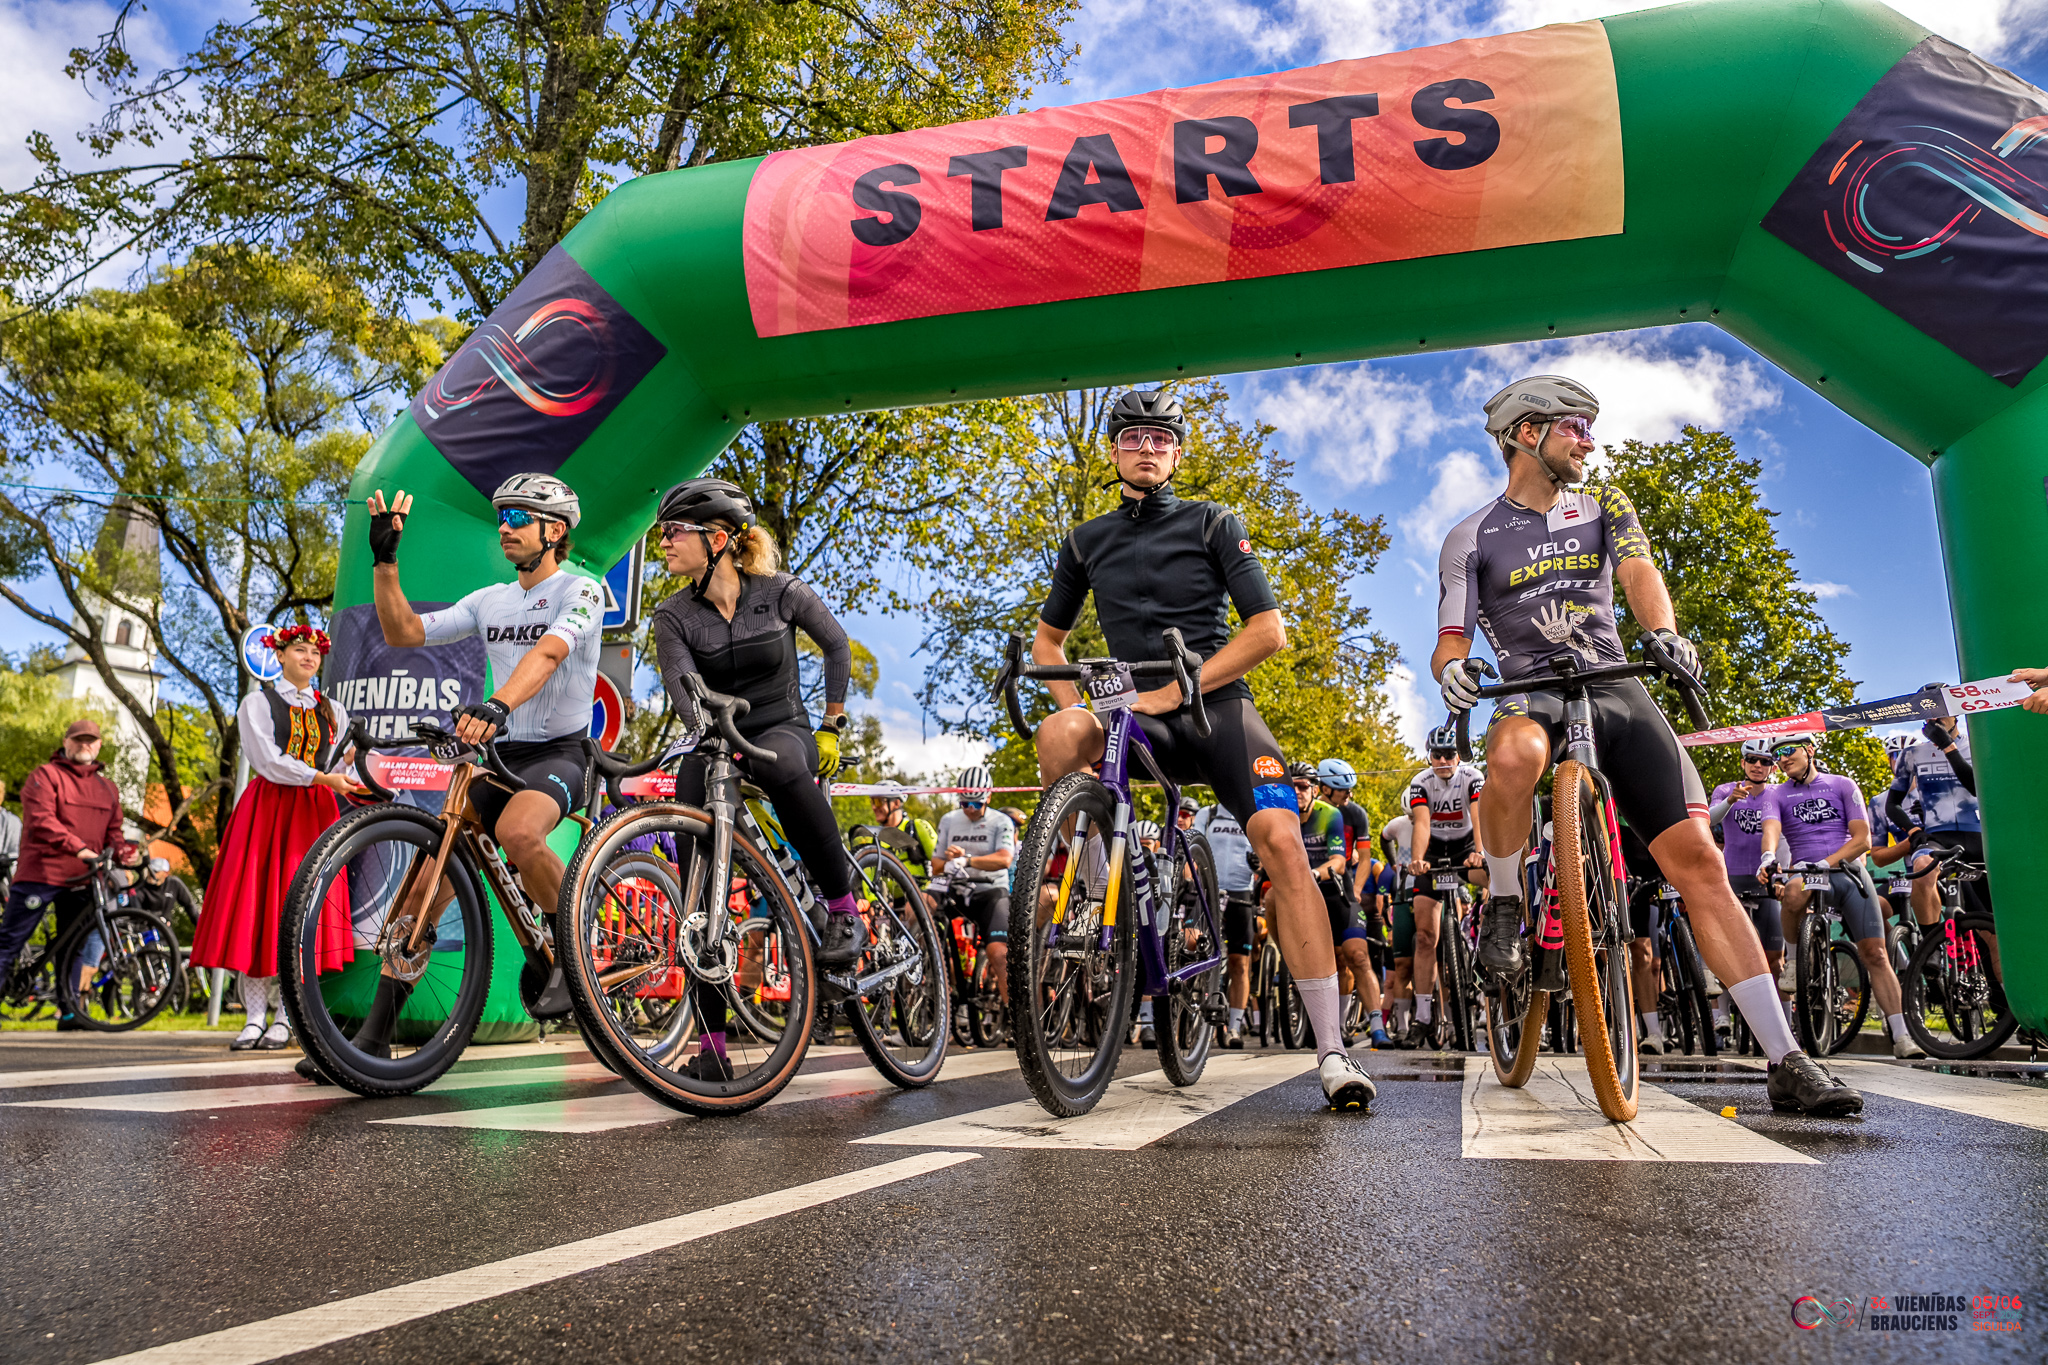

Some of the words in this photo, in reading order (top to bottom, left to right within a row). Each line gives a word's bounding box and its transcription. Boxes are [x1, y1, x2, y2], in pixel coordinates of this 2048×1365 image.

[851, 79, 1501, 247] STARTS
[1522, 395, 1548, 408] ABUS
[1505, 519, 1531, 529] LATVIJA
[1527, 538, 1580, 560] VELO
[1510, 553, 1599, 587] EXPRESS
[1517, 579, 1600, 603] SCOTT
[487, 622, 551, 643] DAKO
[336, 669, 461, 712] VIENĪBAS
[1089, 676, 1124, 698] 1368
[1949, 686, 1981, 698] 58
[1982, 688, 2001, 696] KM
[1105, 697, 1124, 705] TOYOTA
[1961, 699, 1993, 711] 62
[1994, 700, 2014, 708] KM
[1105, 722, 1120, 764] BMC
[379, 761, 408, 769] KALNU
[393, 776, 425, 784] GRAVEL
[1433, 799, 1463, 812] UAE
[1793, 798, 1827, 816] BREAD
[1799, 807, 1838, 823] WATER
[1739, 819, 1762, 831] WATE
[714, 858, 726, 916] TREK
[1437, 875, 1454, 883] 1201
[478, 833, 545, 950] ORBEA
[1662, 883, 1677, 892] 124
